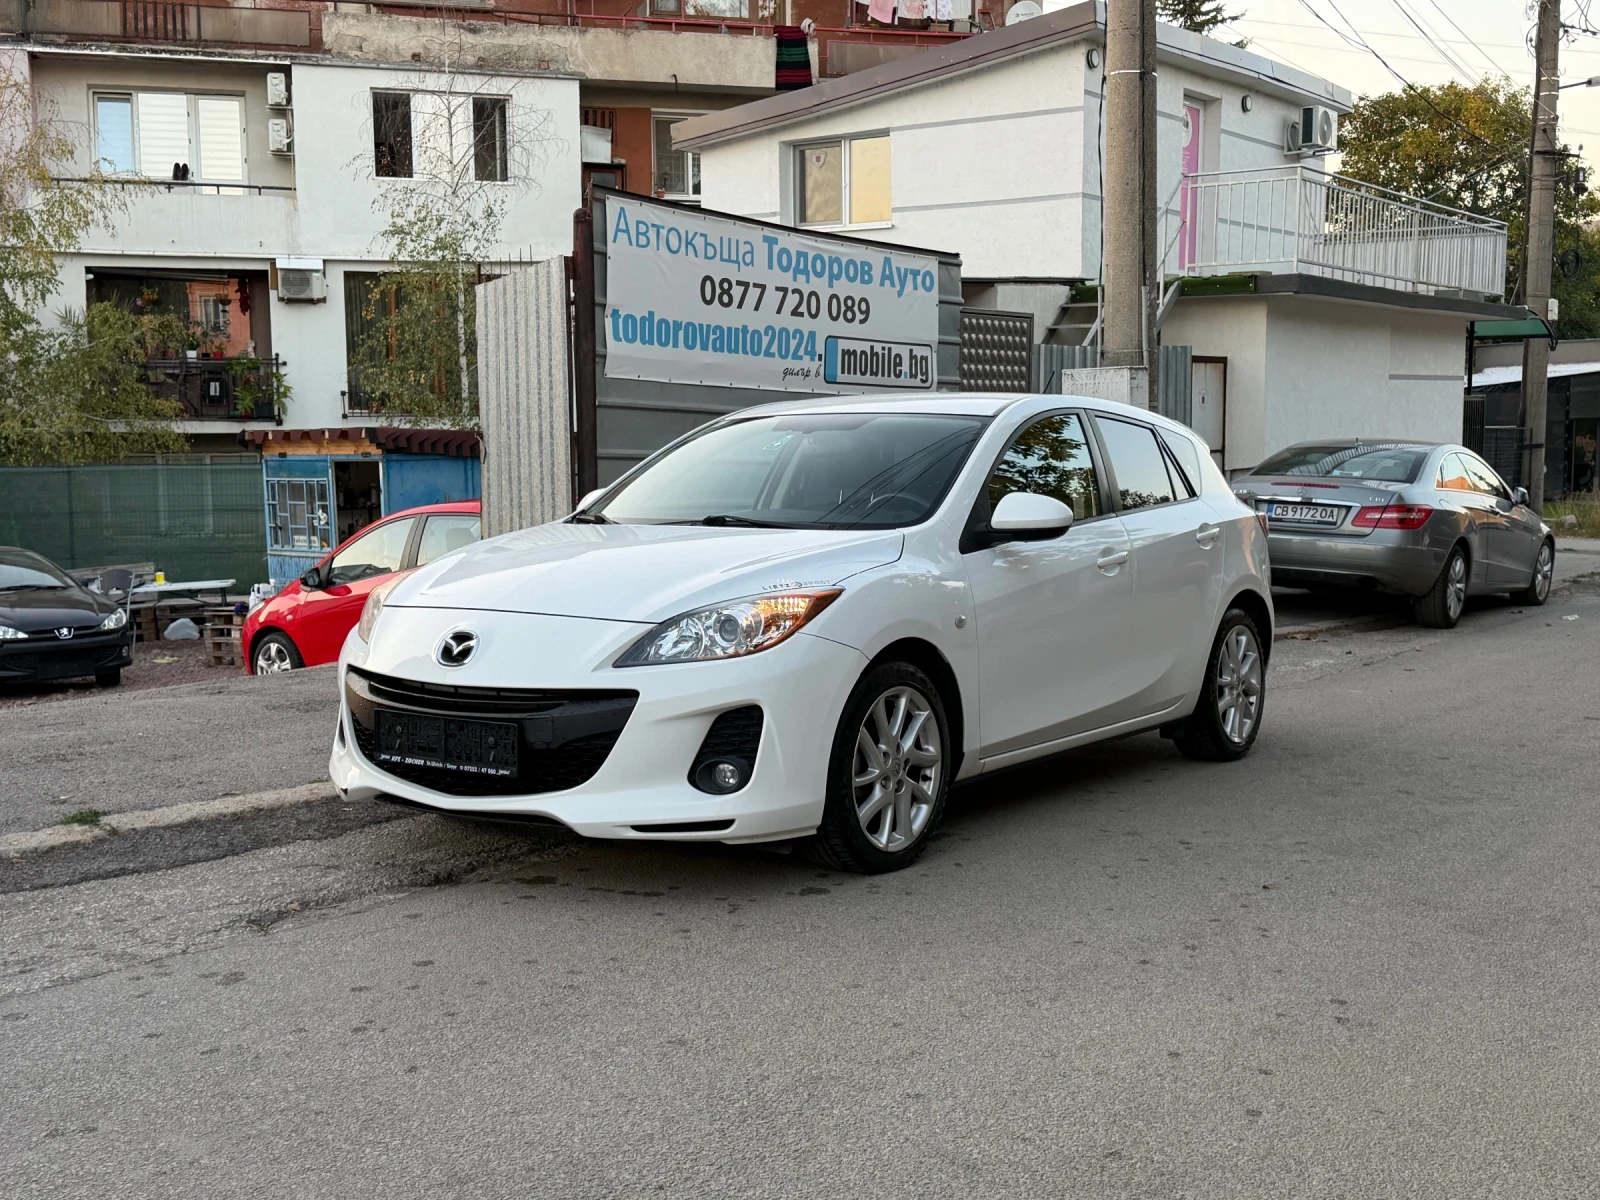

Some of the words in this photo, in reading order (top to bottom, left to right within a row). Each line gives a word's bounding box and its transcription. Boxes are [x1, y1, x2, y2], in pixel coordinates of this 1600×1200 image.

[612, 206, 755, 272] Автокъща
[762, 235, 874, 288] Тодоров
[879, 256, 935, 298] Ауто
[700, 275, 767, 312] 0877
[774, 286, 821, 319] 720
[827, 293, 871, 324] 089
[840, 345, 929, 384] mobile.bg
[1274, 505, 1289, 517] CB
[1291, 506, 1318, 518] 9172
[1320, 508, 1335, 520] OA
